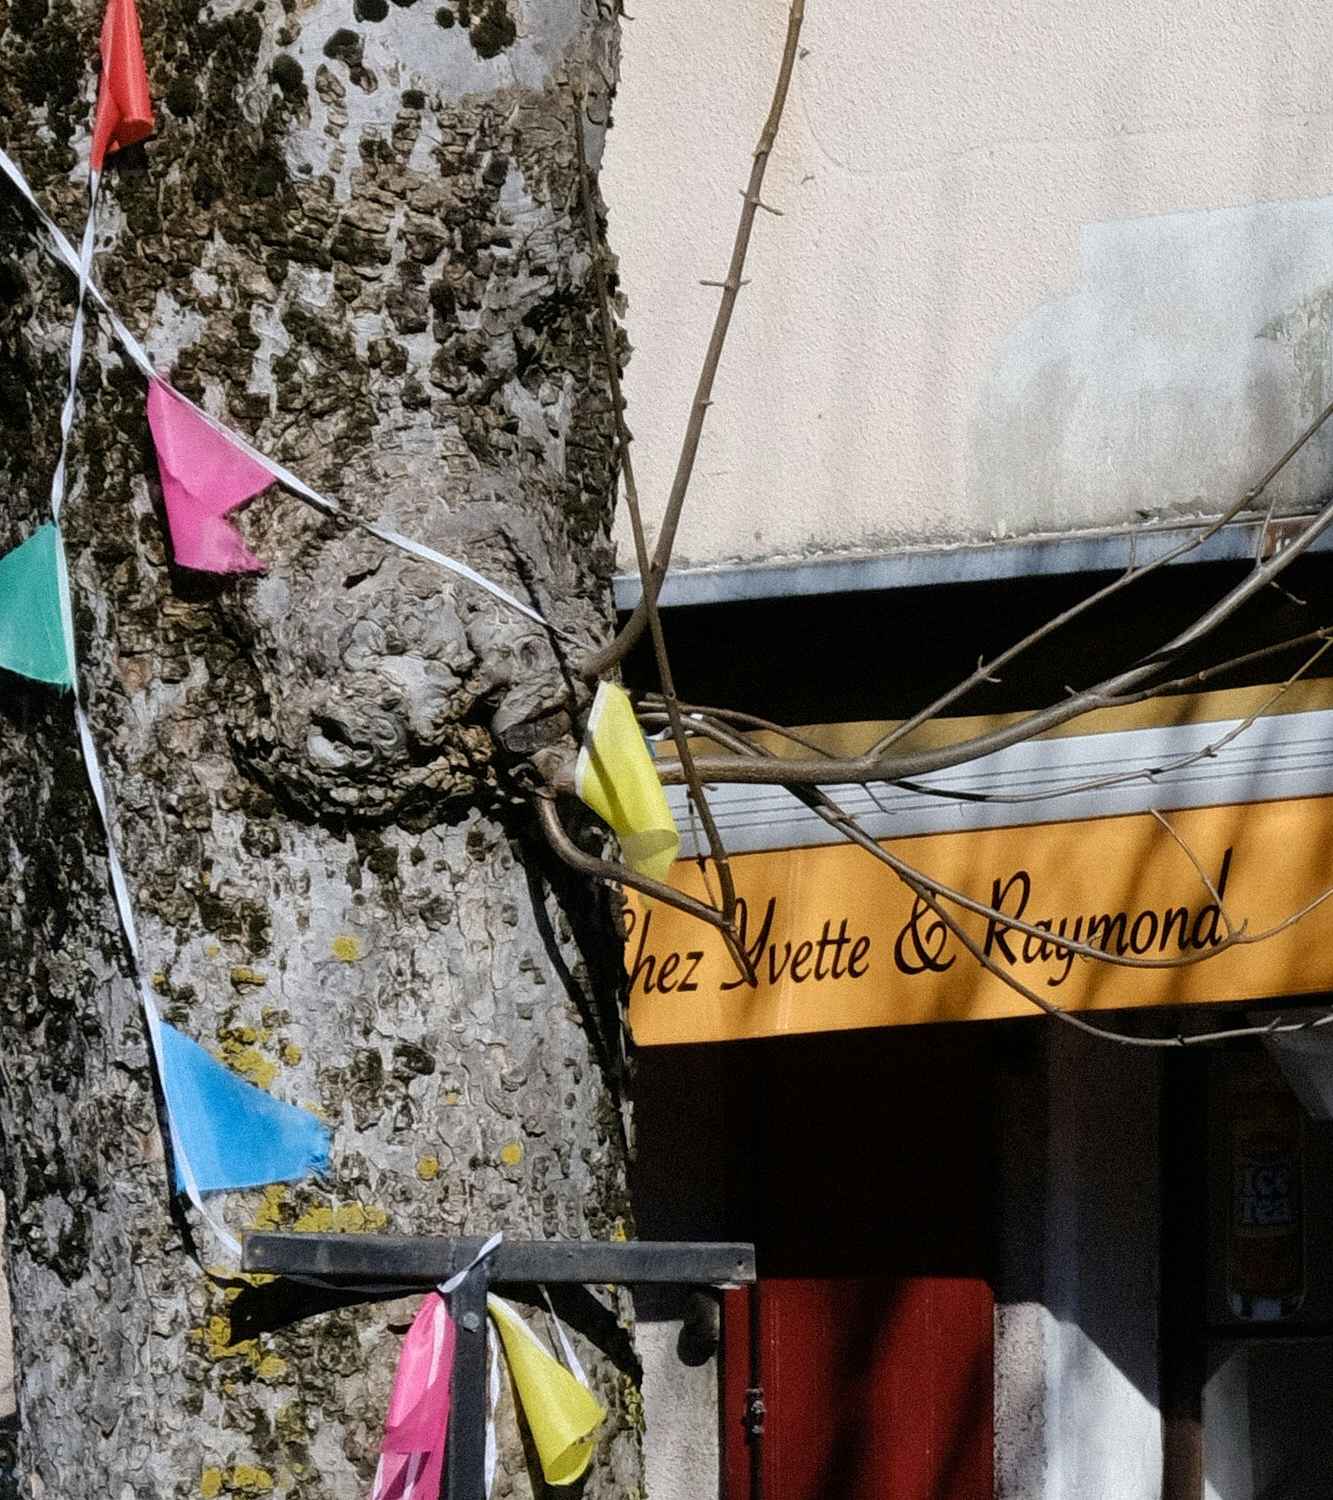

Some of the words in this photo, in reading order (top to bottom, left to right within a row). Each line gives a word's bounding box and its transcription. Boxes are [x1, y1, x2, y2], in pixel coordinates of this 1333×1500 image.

[623, 907, 705, 995] hez
[720, 896, 871, 990] Yvette
[894, 891, 957, 975] &
[979, 845, 1233, 987] Raymond
